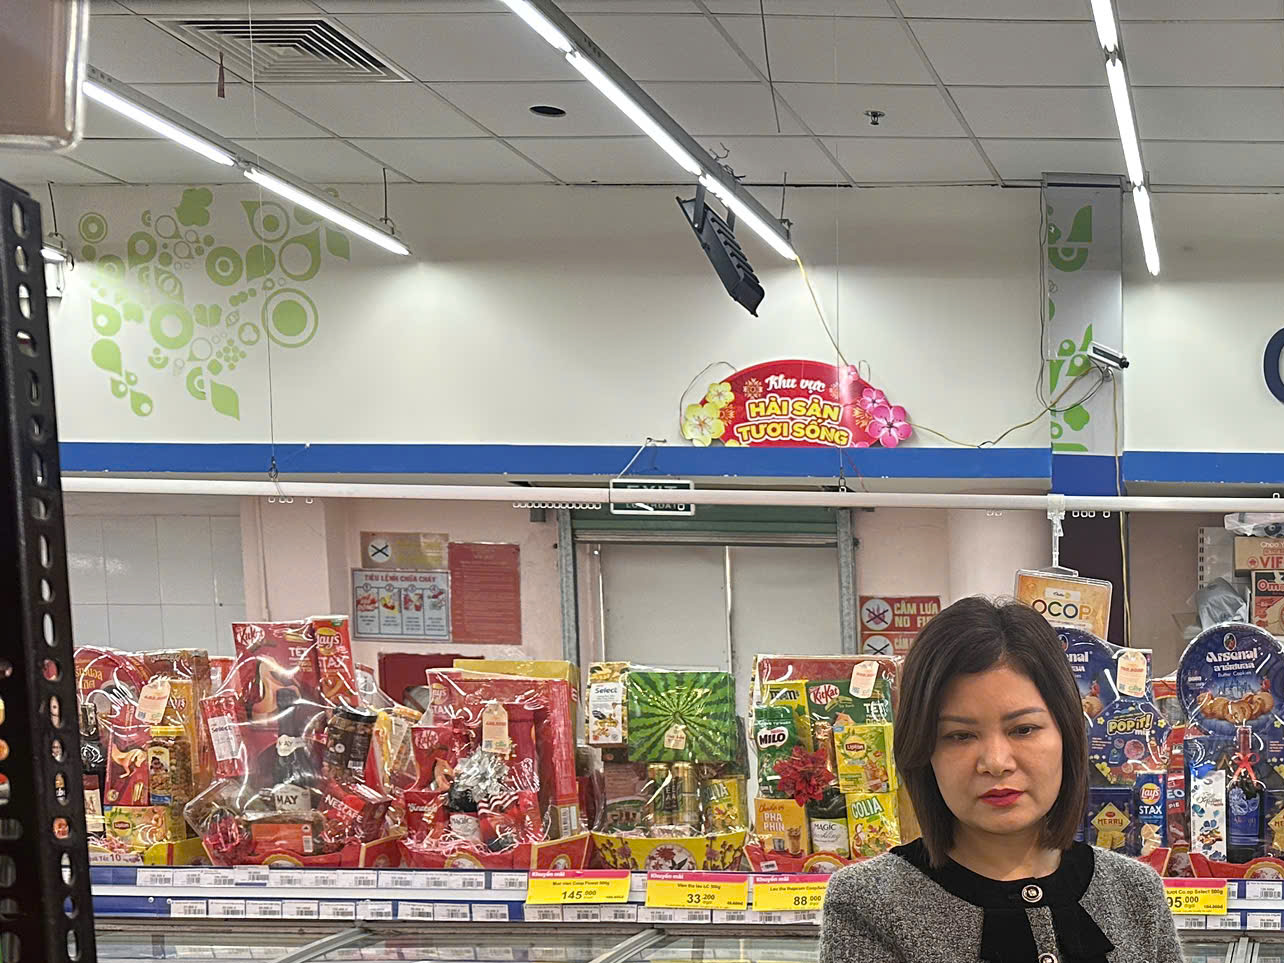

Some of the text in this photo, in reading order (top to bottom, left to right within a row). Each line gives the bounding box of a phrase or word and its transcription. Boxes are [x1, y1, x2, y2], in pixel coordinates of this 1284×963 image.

[765, 374, 826, 393] Khu vực
[748, 397, 841, 420] HẢI SẢN
[736, 418, 850, 446] TƯƠI SỐNG
[894, 601, 916, 614] CẤM
[1032, 600, 1092, 620] OCOP
[895, 616, 910, 627] NO
[1206, 648, 1258, 662] Arsenal
[812, 684, 839, 704] KitKat
[1109, 719, 1134, 734] POP
[759, 733, 786, 746] MILO
[851, 797, 883, 818] COLIA
[1139, 806, 1162, 815] STAX
